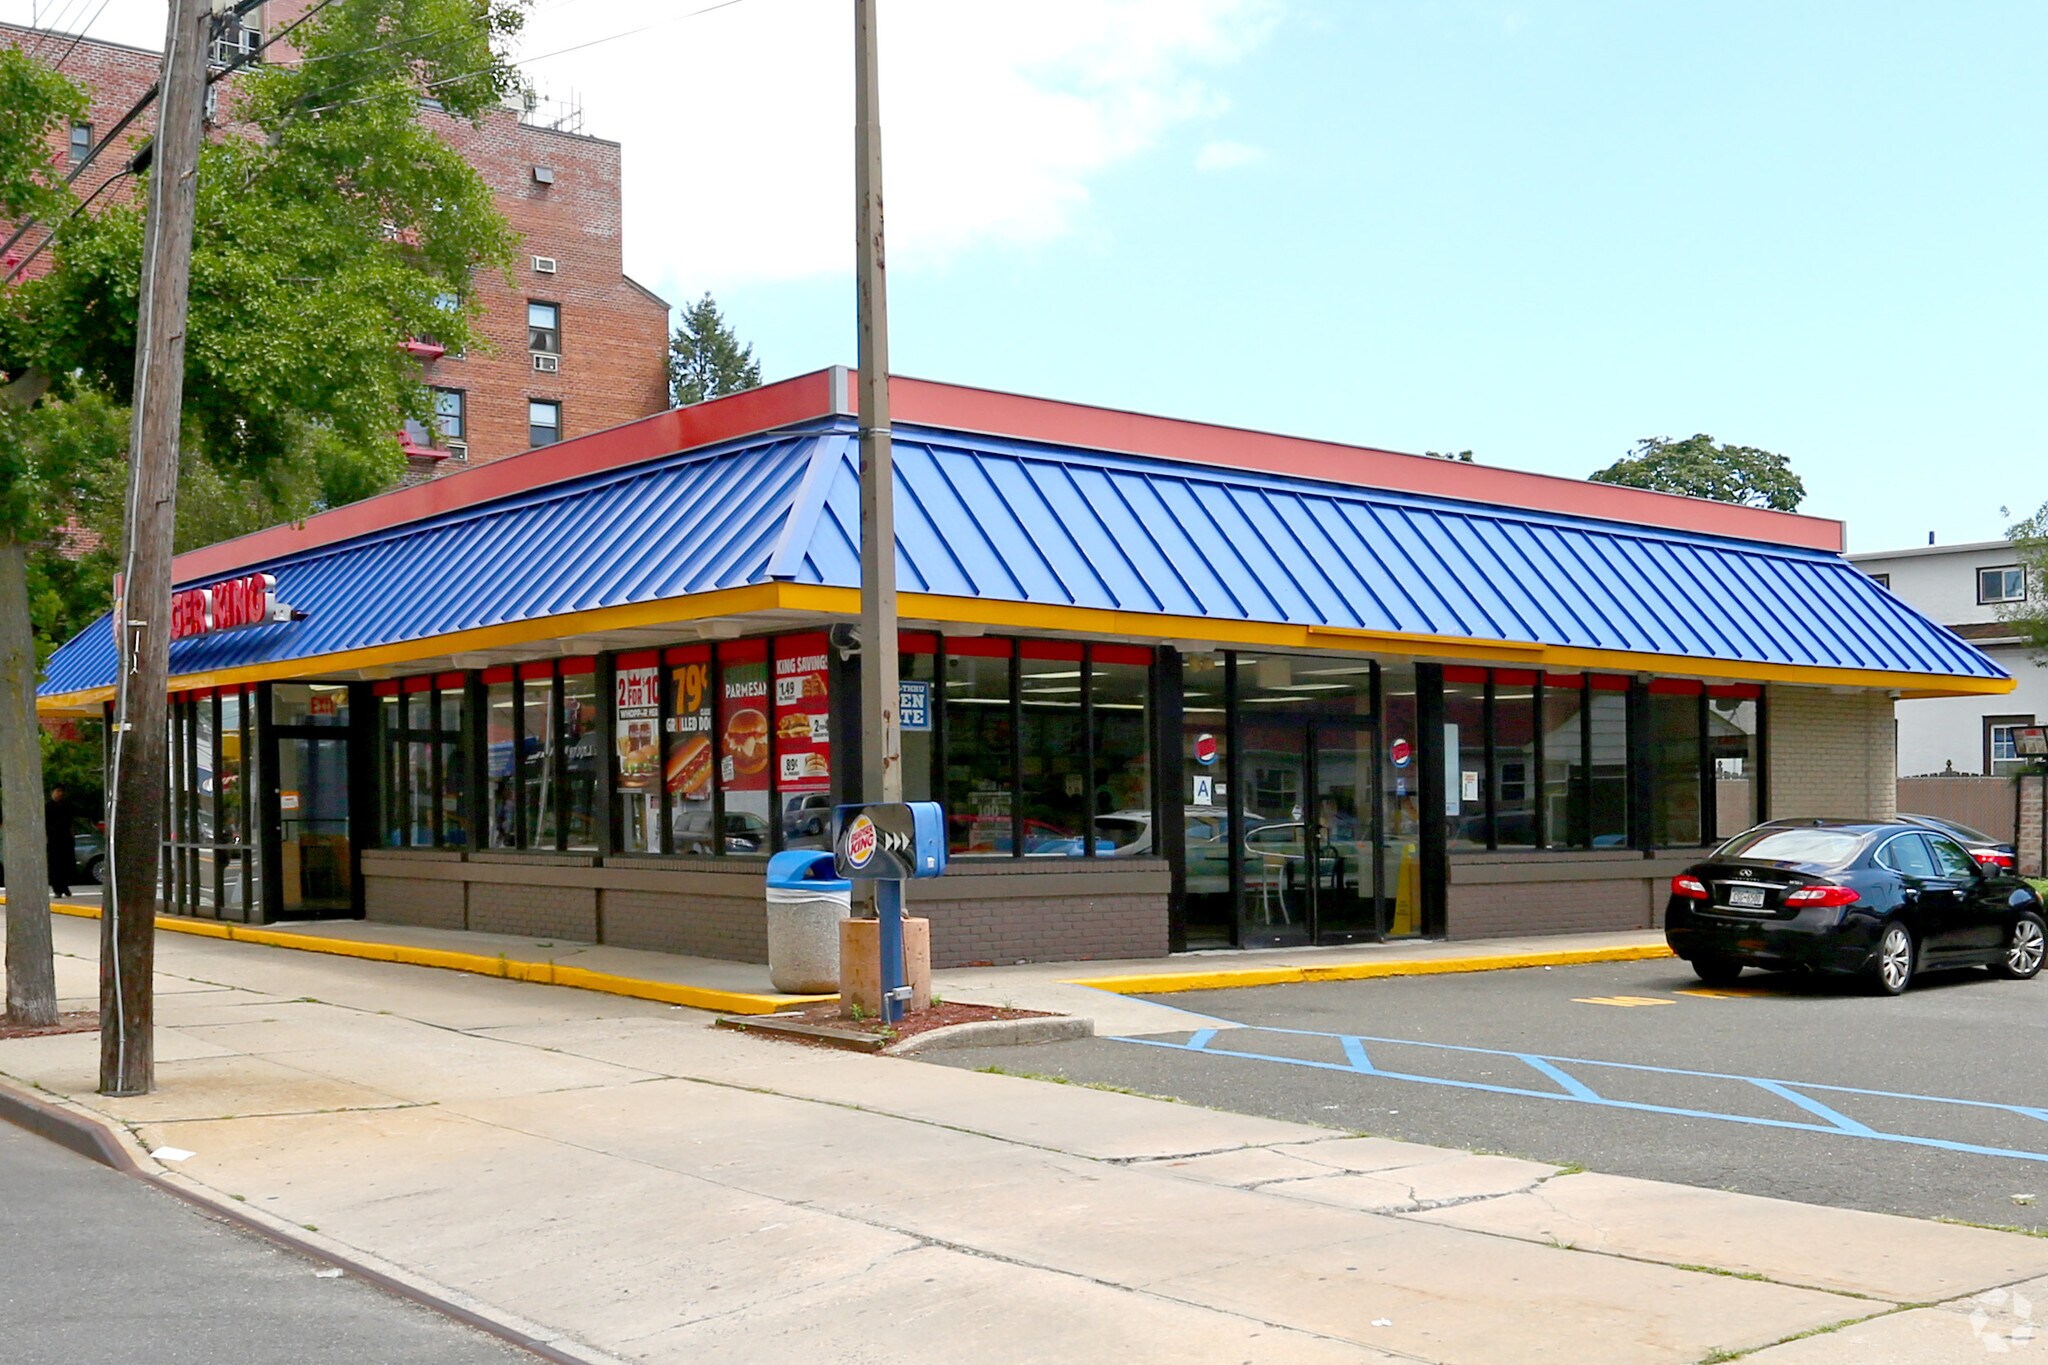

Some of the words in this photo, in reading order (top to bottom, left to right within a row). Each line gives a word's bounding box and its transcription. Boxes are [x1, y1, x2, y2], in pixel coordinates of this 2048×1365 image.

[171, 588, 208, 639] GER
[211, 573, 266, 630] KING
[776, 658, 796, 674] KING
[619, 678, 626, 706] 2
[628, 688, 642, 706] FOR
[900, 693, 925, 708] EN
[900, 709, 924, 724] TE
[1197, 780, 1209, 798] A
[850, 833, 874, 856] KING
